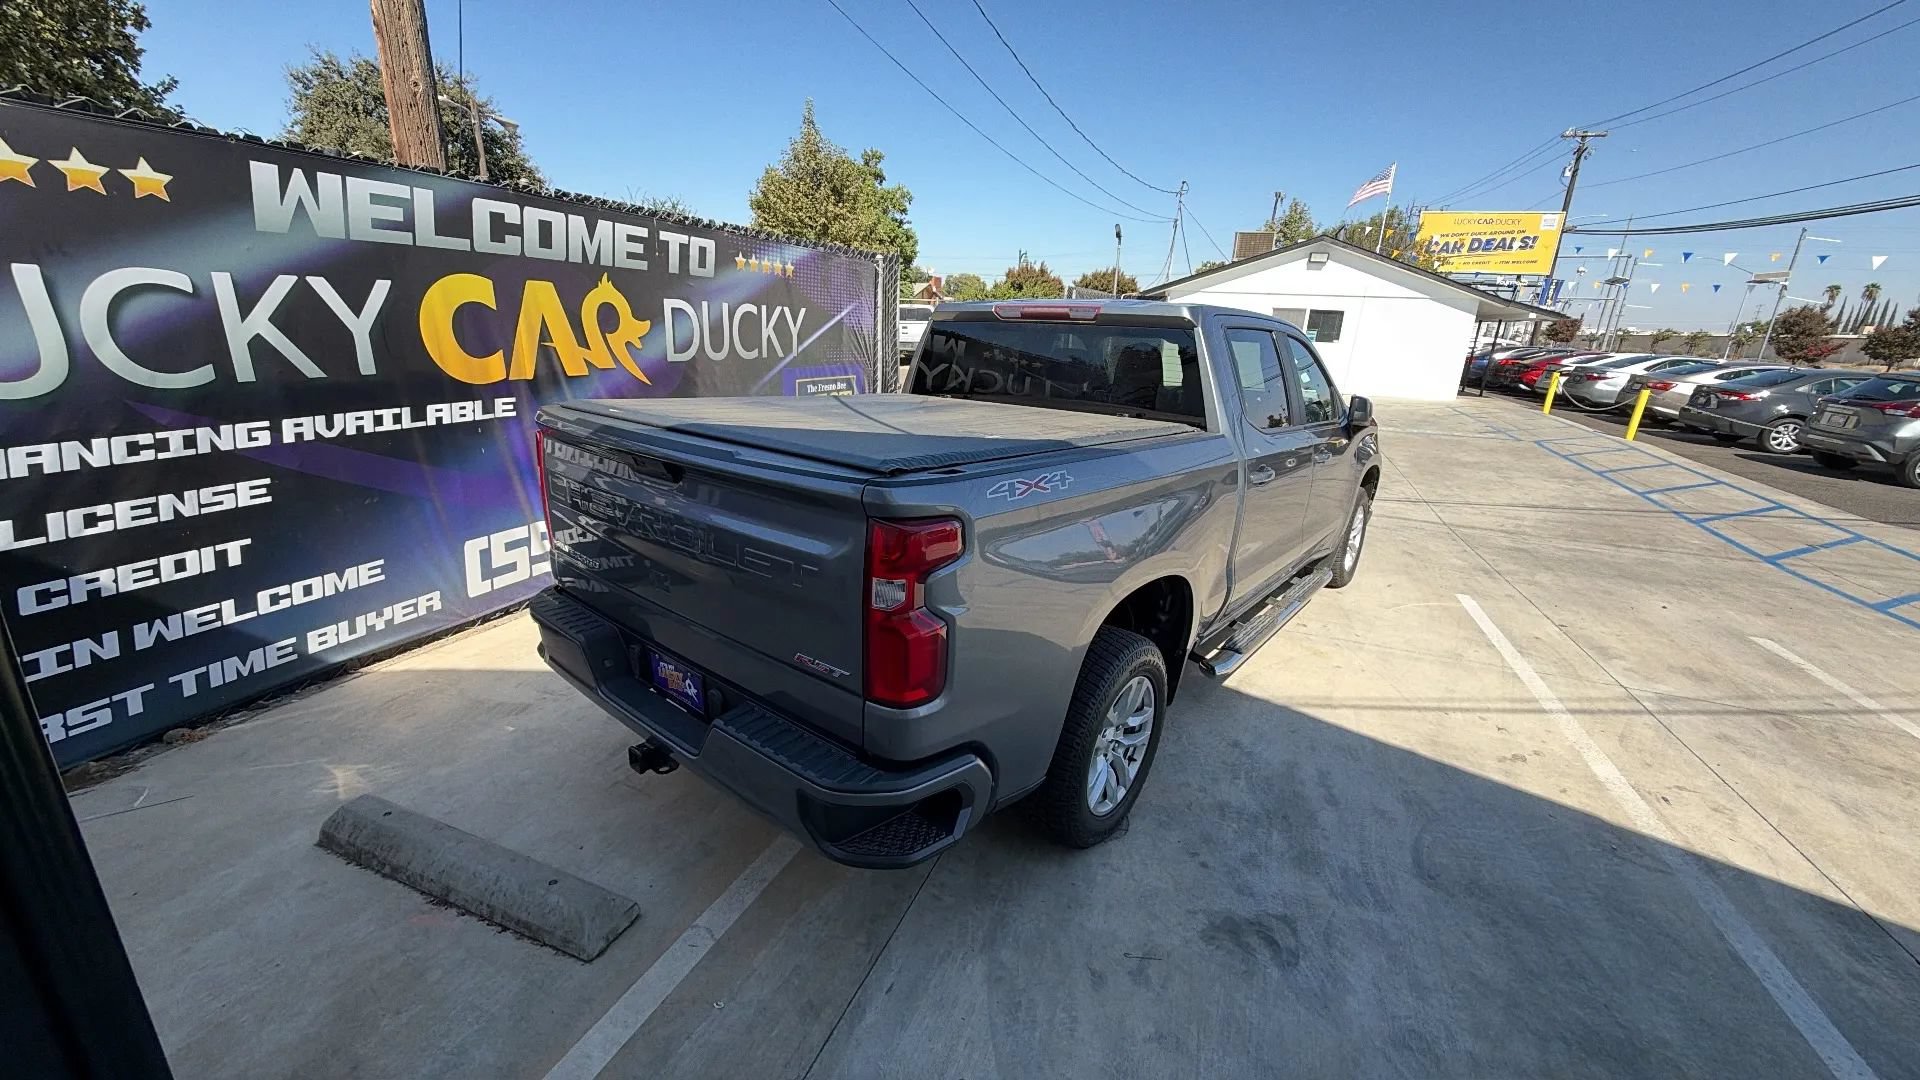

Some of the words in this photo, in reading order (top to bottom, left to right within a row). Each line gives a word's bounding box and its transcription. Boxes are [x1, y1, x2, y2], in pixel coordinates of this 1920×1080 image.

[249, 160, 648, 271] WELCOME
[660, 231, 715, 277] TO
[1424, 236, 1465, 254] CAR
[1467, 235, 1539, 253] DEALS!
[419, 272, 652, 385] CAR
[664, 298, 807, 362] DUCKY
[281, 397, 517, 444] AVAILABLE
[807, 384, 818, 394] The
[818, 383, 837, 392] Fresno
[837, 382, 847, 390] Bee
[0, 477, 272, 552] LICENSE
[17, 538, 252, 616] CREDIT
[19, 630, 121, 682] IN
[133, 559, 386, 651] WELCOME
[168, 637, 299, 699] TIME
[306, 590, 442, 655] BUYER
